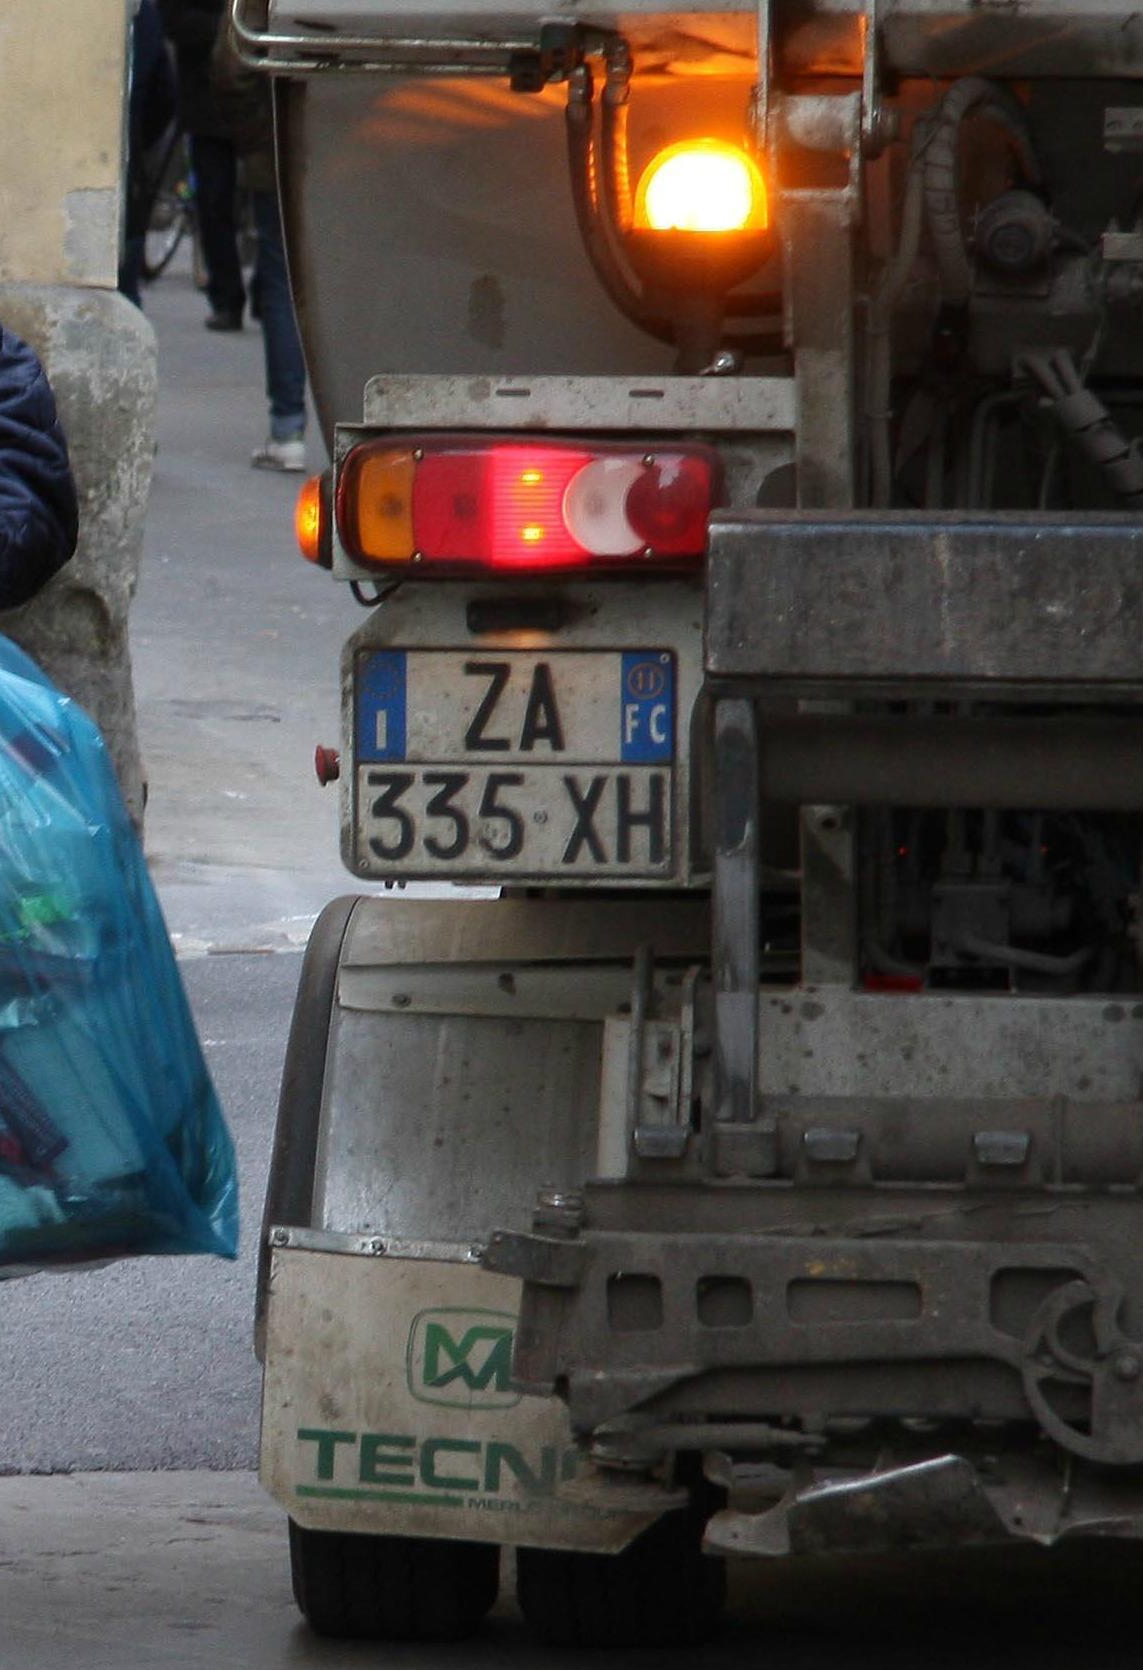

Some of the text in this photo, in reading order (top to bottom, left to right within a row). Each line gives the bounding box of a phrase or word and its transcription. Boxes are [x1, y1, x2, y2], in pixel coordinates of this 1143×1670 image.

[375, 709, 387, 750] I
[464, 662, 565, 751] ZA
[625, 703, 666, 744] FC
[367, 772, 665, 864] 335 XH
